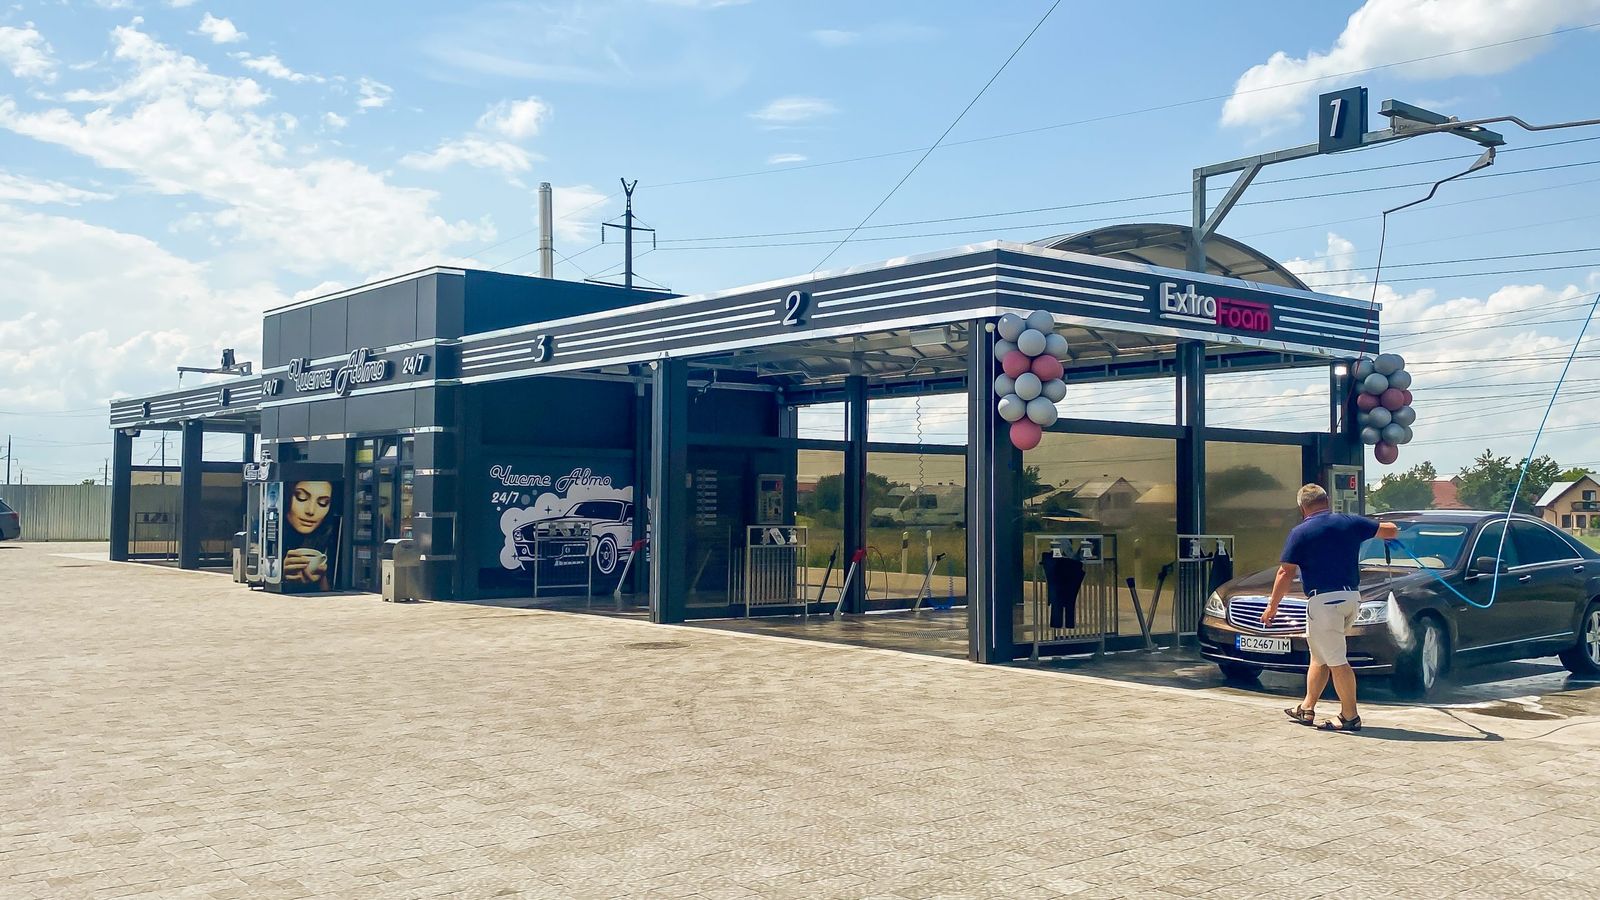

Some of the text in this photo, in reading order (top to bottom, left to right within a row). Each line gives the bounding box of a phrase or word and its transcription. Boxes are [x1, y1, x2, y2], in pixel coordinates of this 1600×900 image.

[1330, 98, 1342, 136] 1
[783, 290, 801, 326] 2
[1160, 282, 1217, 318] Extra
[1216, 298, 1272, 332] Foam
[534, 335, 546, 362] 3
[335, 347, 388, 396] Авто
[402, 354, 425, 375] 24/7
[263, 378, 279, 395] 24/7
[490, 465, 611, 492] Чисте Авто
[492, 491, 519, 504] 24/7
[1240, 637, 1290, 651] BC 2467 IM
